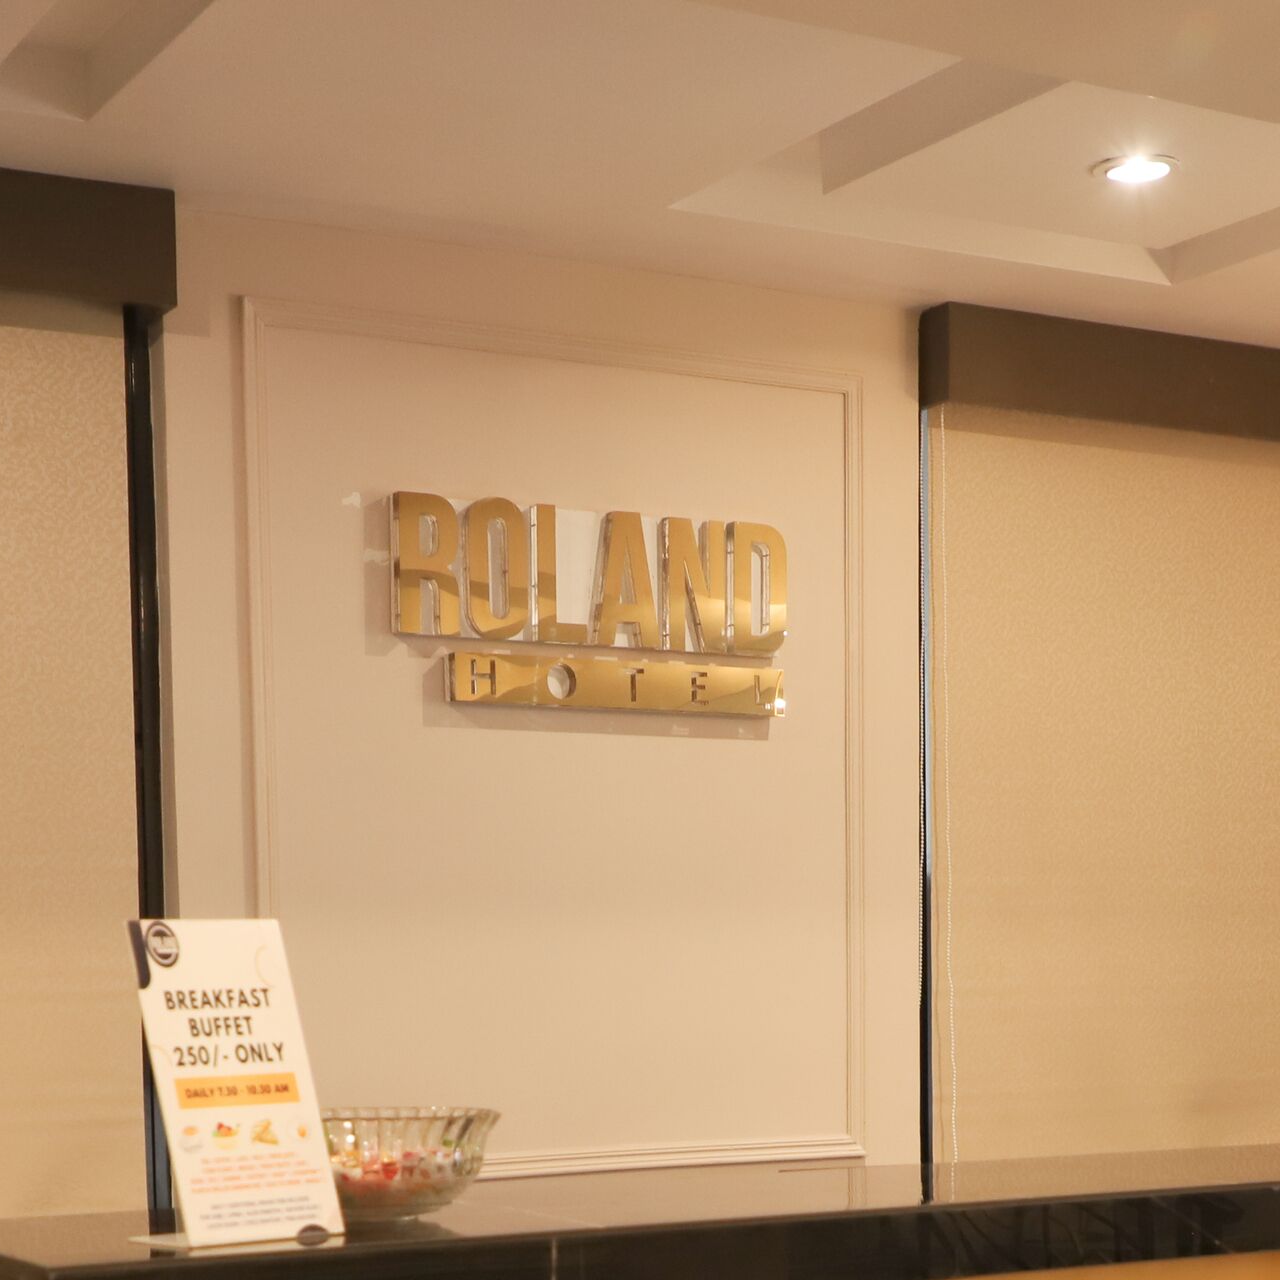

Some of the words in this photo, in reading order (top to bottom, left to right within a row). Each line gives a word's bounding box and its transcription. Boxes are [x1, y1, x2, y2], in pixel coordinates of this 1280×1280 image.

[391, 491, 787, 655] ROLAND
[470, 657, 776, 709] HOTEL
[164, 988, 270, 1010] BREAKFAST
[188, 1016, 253, 1037] BUFFET
[235, 1042, 284, 1063] ONLY
[274, 1083, 290, 1094] AM
